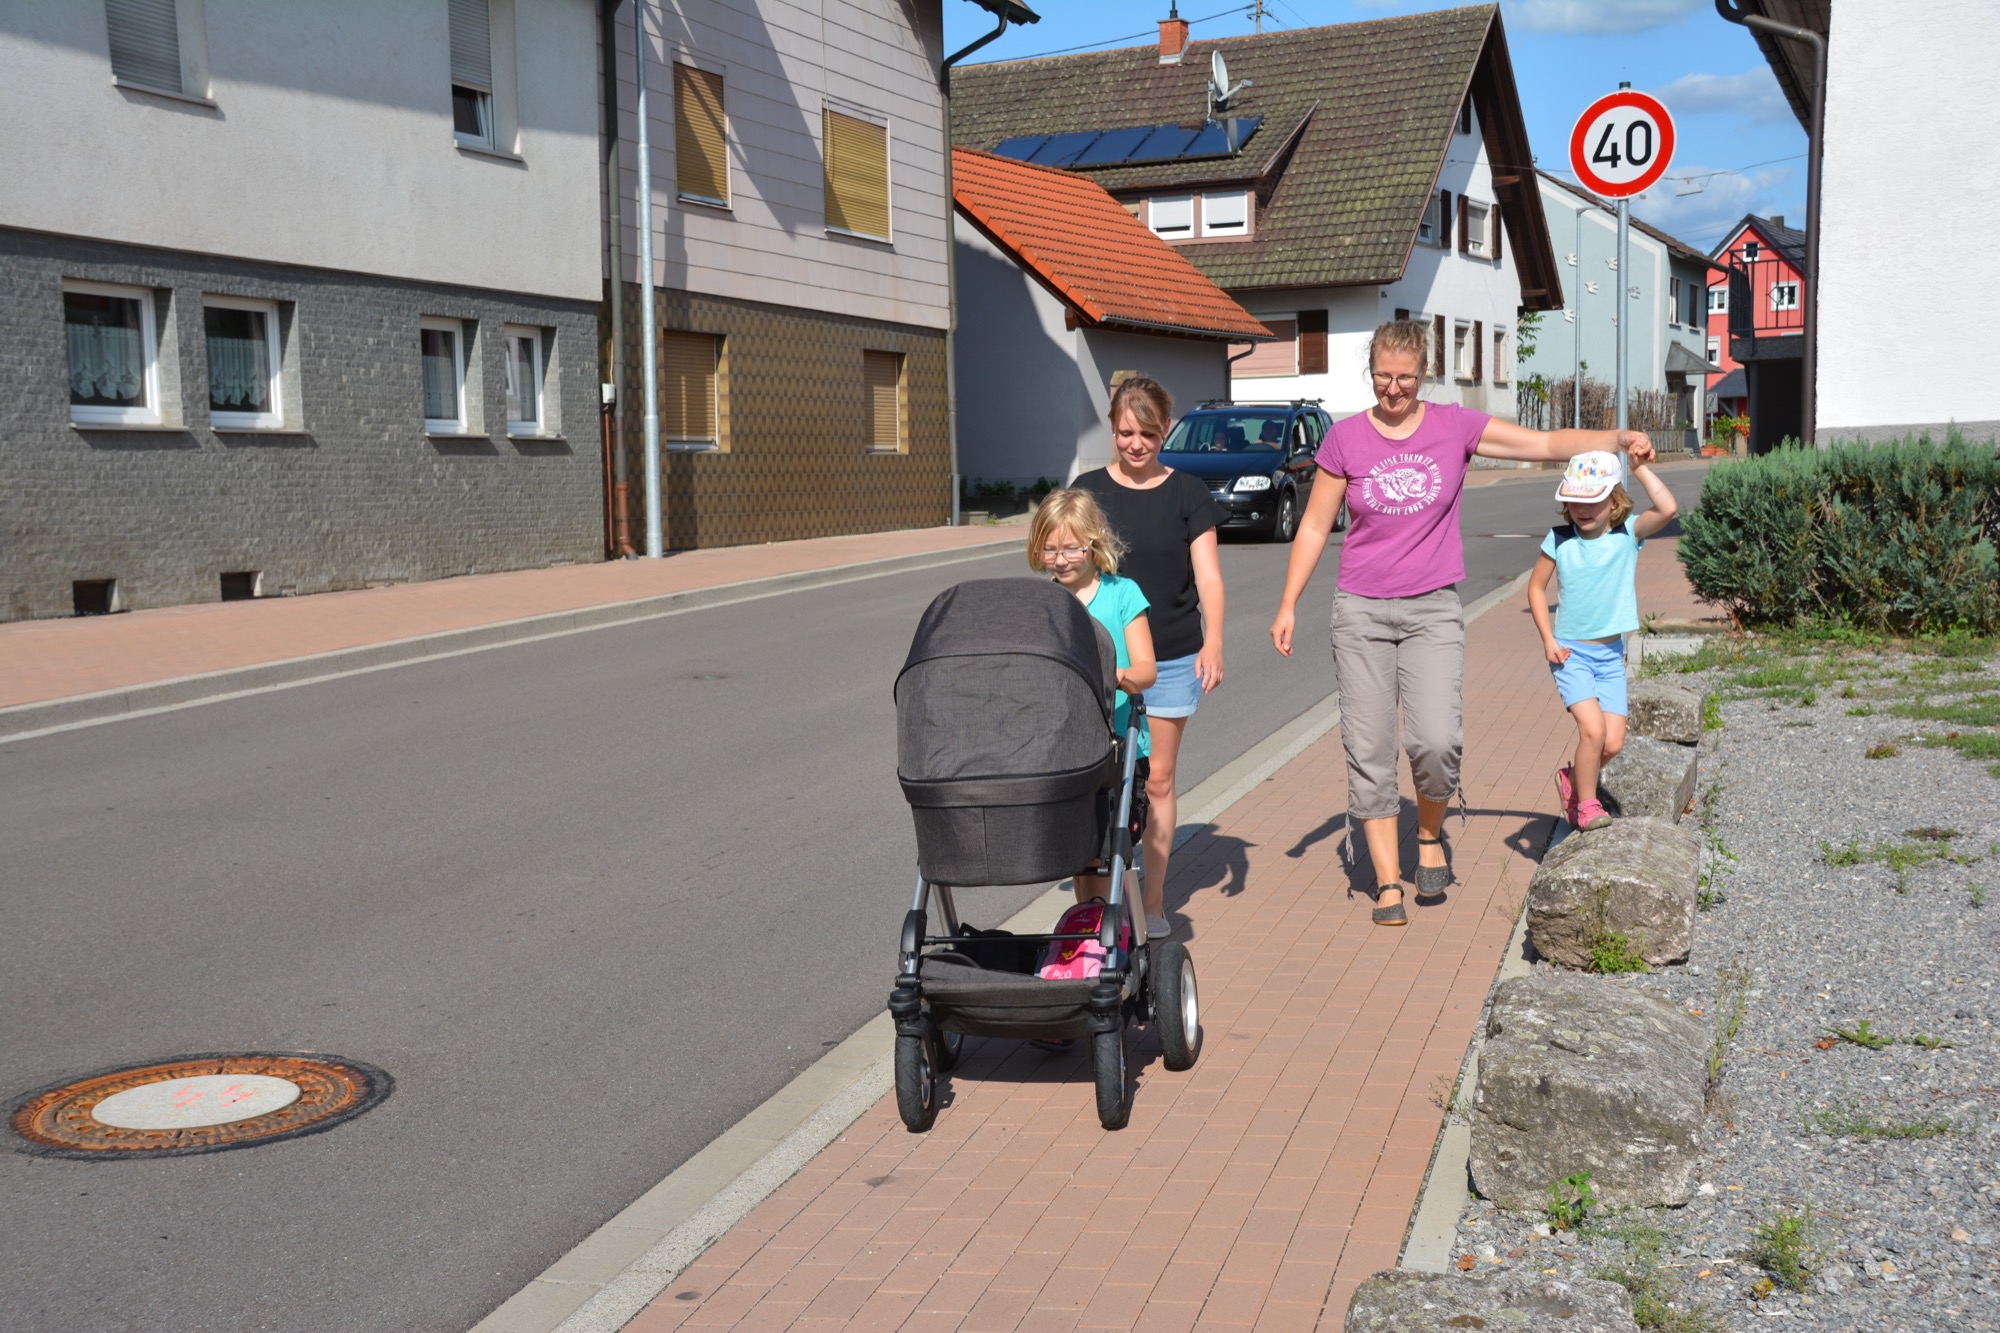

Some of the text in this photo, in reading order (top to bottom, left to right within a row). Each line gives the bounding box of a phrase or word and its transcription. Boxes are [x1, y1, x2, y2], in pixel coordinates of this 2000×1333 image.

[1592, 120, 1652, 168] 40
[1400, 453, 1423, 463] TOKYO
[1423, 485, 1441, 505] SINCE
[1382, 507, 1400, 515] LIVE
[1404, 502, 1424, 515] 2007
